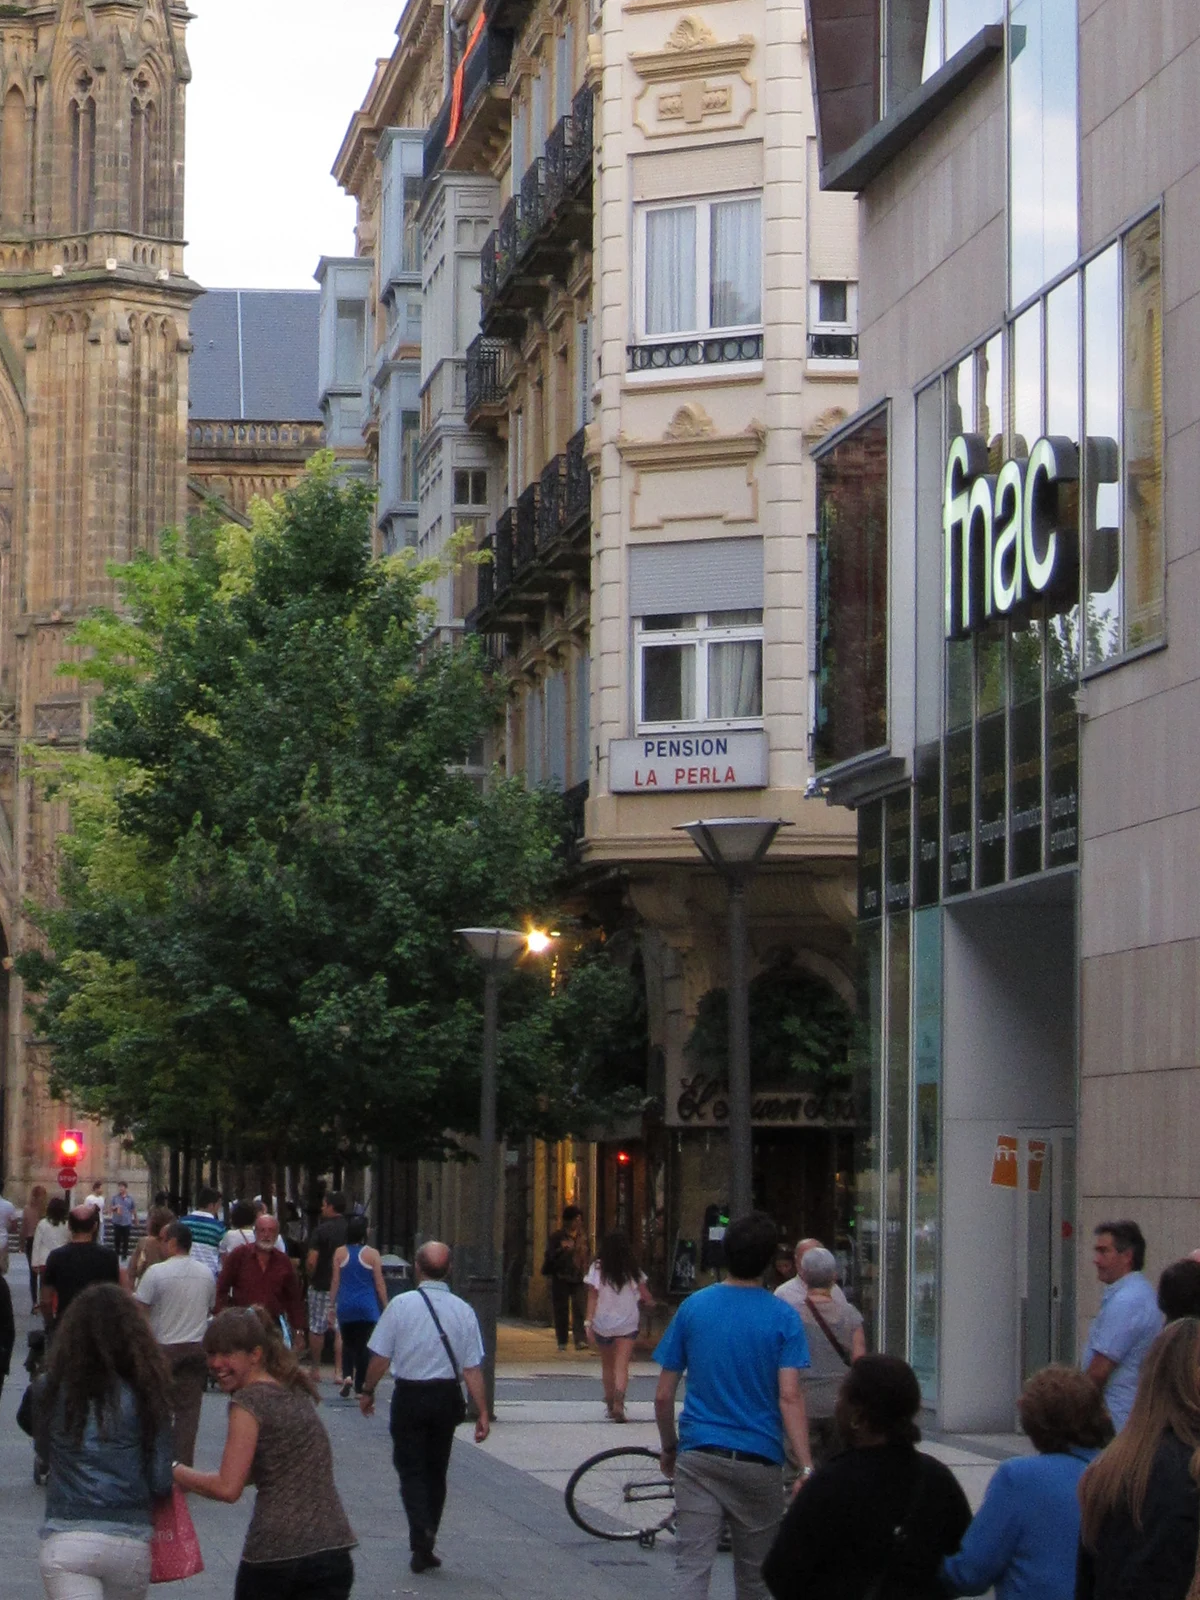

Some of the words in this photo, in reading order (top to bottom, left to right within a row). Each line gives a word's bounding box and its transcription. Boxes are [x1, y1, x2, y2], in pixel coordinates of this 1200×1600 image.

[943, 434, 1060, 639] fnac
[644, 738, 728, 758] PENSION
[633, 769, 657, 787] LA
[675, 766, 736, 785] PERLA
